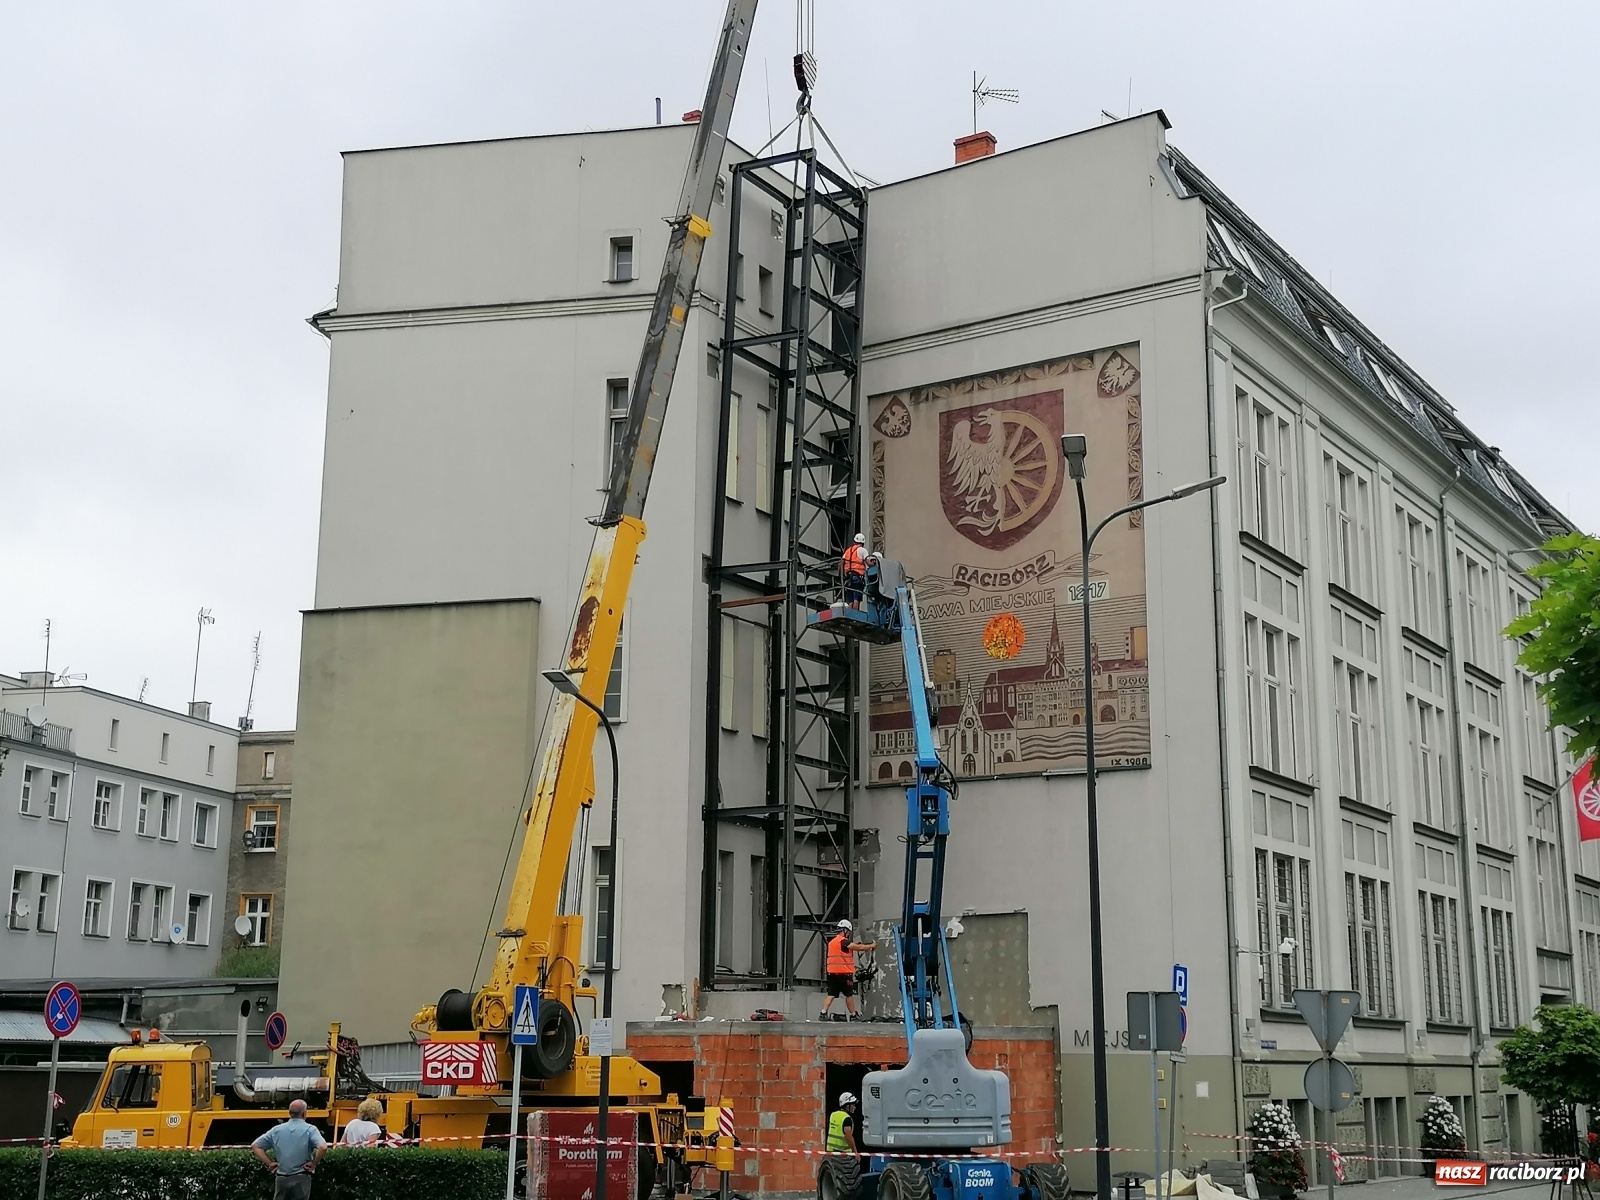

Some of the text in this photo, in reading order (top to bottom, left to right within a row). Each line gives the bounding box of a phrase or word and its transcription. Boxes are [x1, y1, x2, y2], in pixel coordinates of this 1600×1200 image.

[969, 588, 1056, 614] MIEJSKIE
[1068, 582, 1107, 601] 1217
[1125, 757, 1148, 766] 1988
[1175, 970, 1185, 993] P
[426, 1061, 475, 1079] CKD
[904, 1088, 977, 1111] Genie
[169, 1116, 178, 1124] 80
[558, 1148, 623, 1160] Porothrm
[967, 1168, 992, 1178] Genie
[965, 1178, 994, 1188] BOOM
